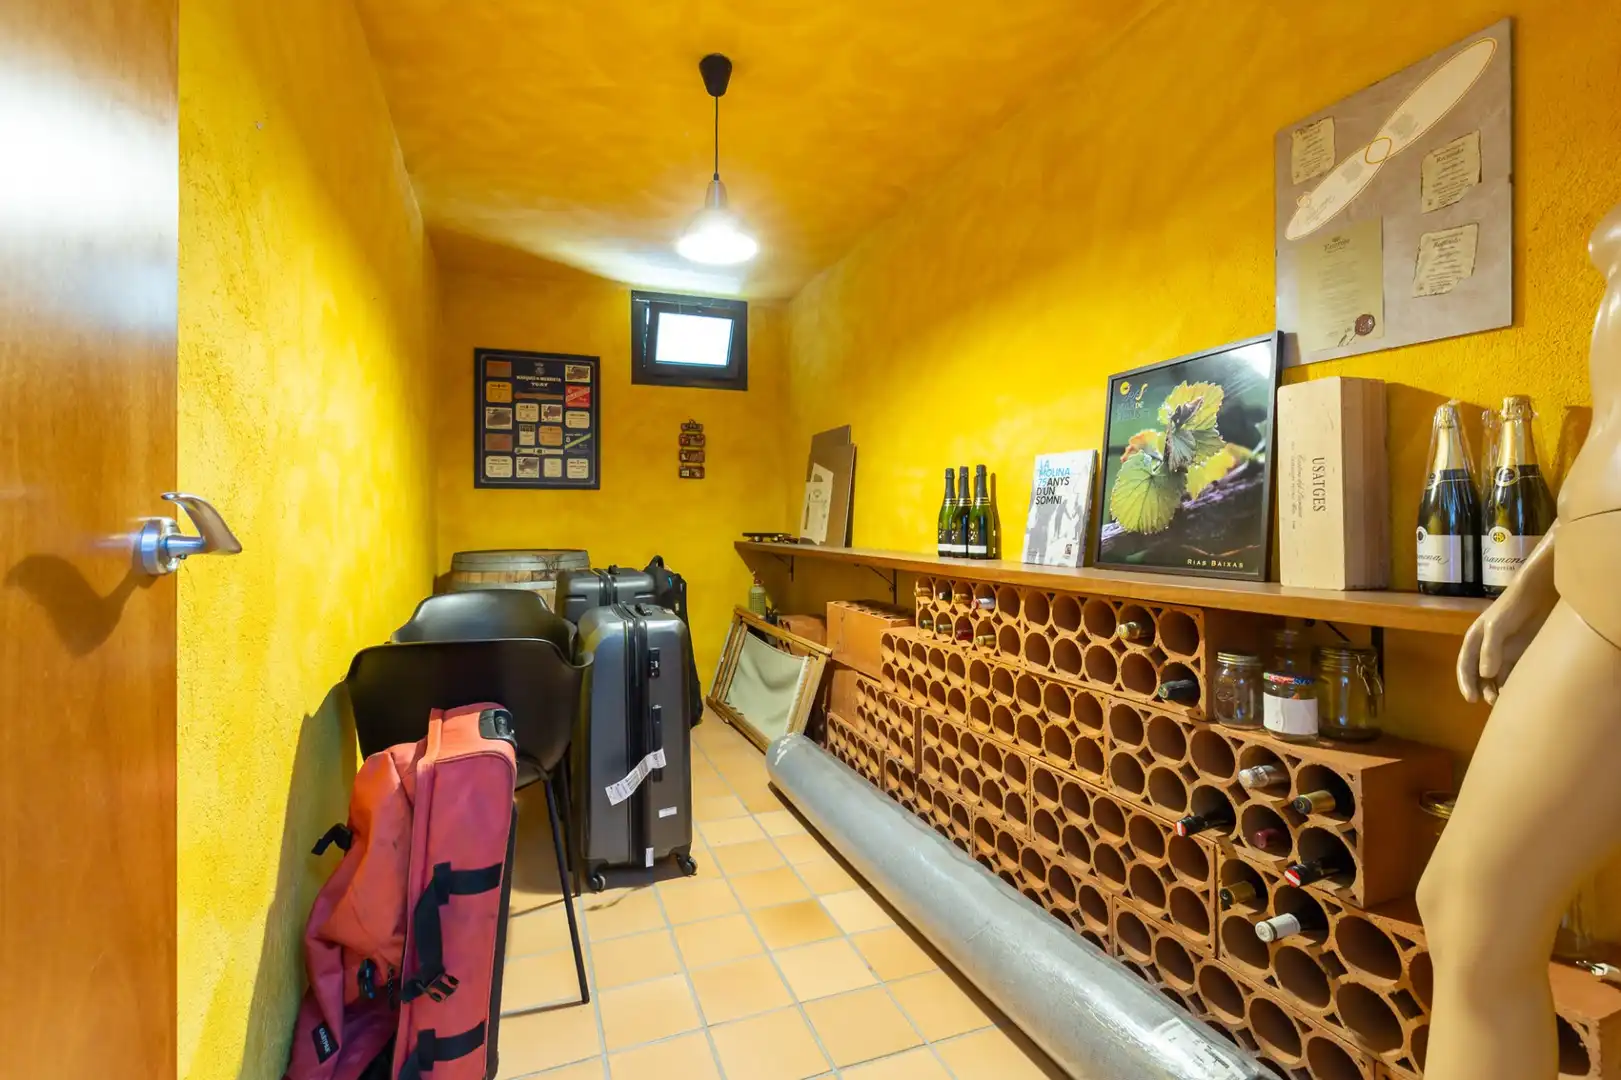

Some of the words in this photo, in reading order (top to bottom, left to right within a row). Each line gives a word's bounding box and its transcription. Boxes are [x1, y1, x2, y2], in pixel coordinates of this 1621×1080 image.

[1039, 460, 1049, 469] LA
[1038, 467, 1070, 477] MOLINA
[1047, 476, 1070, 486] ANYS
[1312, 456, 1326, 512] USATGES
[1035, 496, 1062, 505] SOMNI
